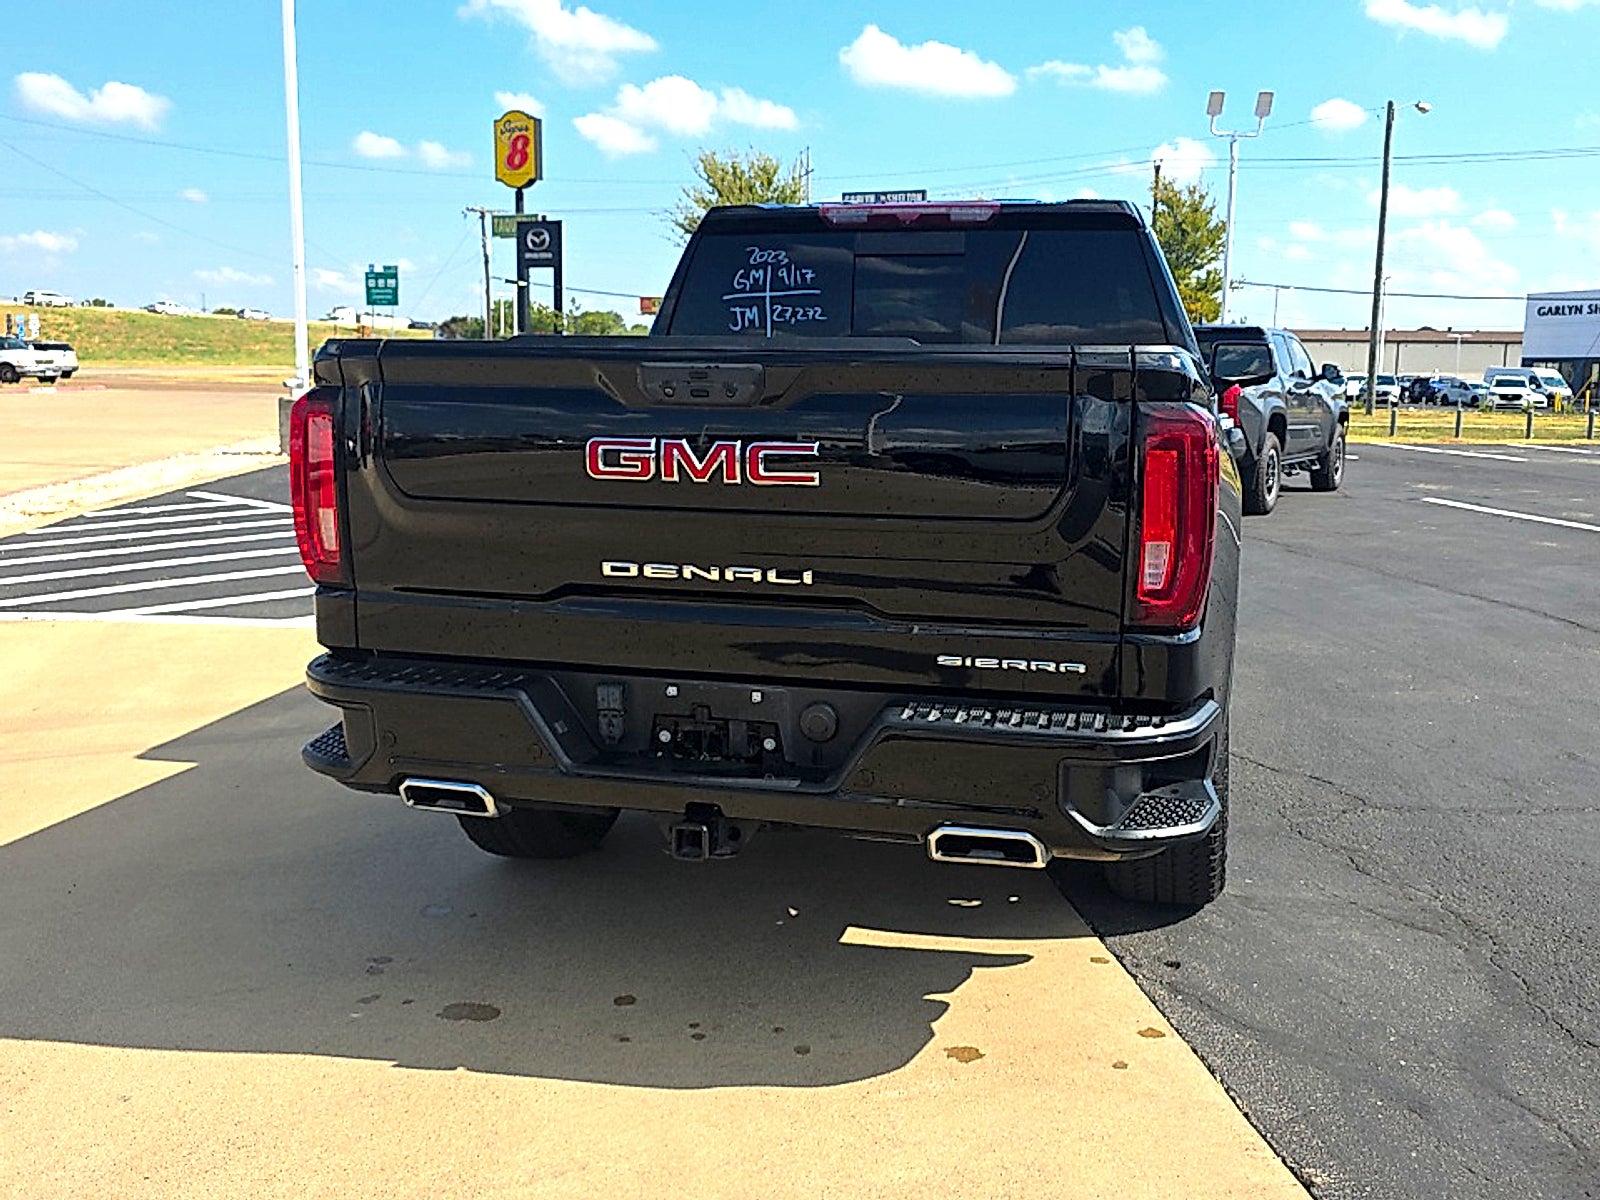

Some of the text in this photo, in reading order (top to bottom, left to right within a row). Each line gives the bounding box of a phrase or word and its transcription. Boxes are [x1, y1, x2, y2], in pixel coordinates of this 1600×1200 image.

[505, 133, 530, 171] 8
[746, 246, 789, 265] 2023
[733, 268, 764, 291] GM
[777, 263, 816, 288] 9/17
[728, 305, 760, 332] JM
[772, 304, 828, 325] 27,272
[1537, 305, 1583, 317] GARLYN
[586, 437, 820, 487] GMC
[601, 561, 814, 586] DENALI
[936, 655, 1088, 674] SIERRA
